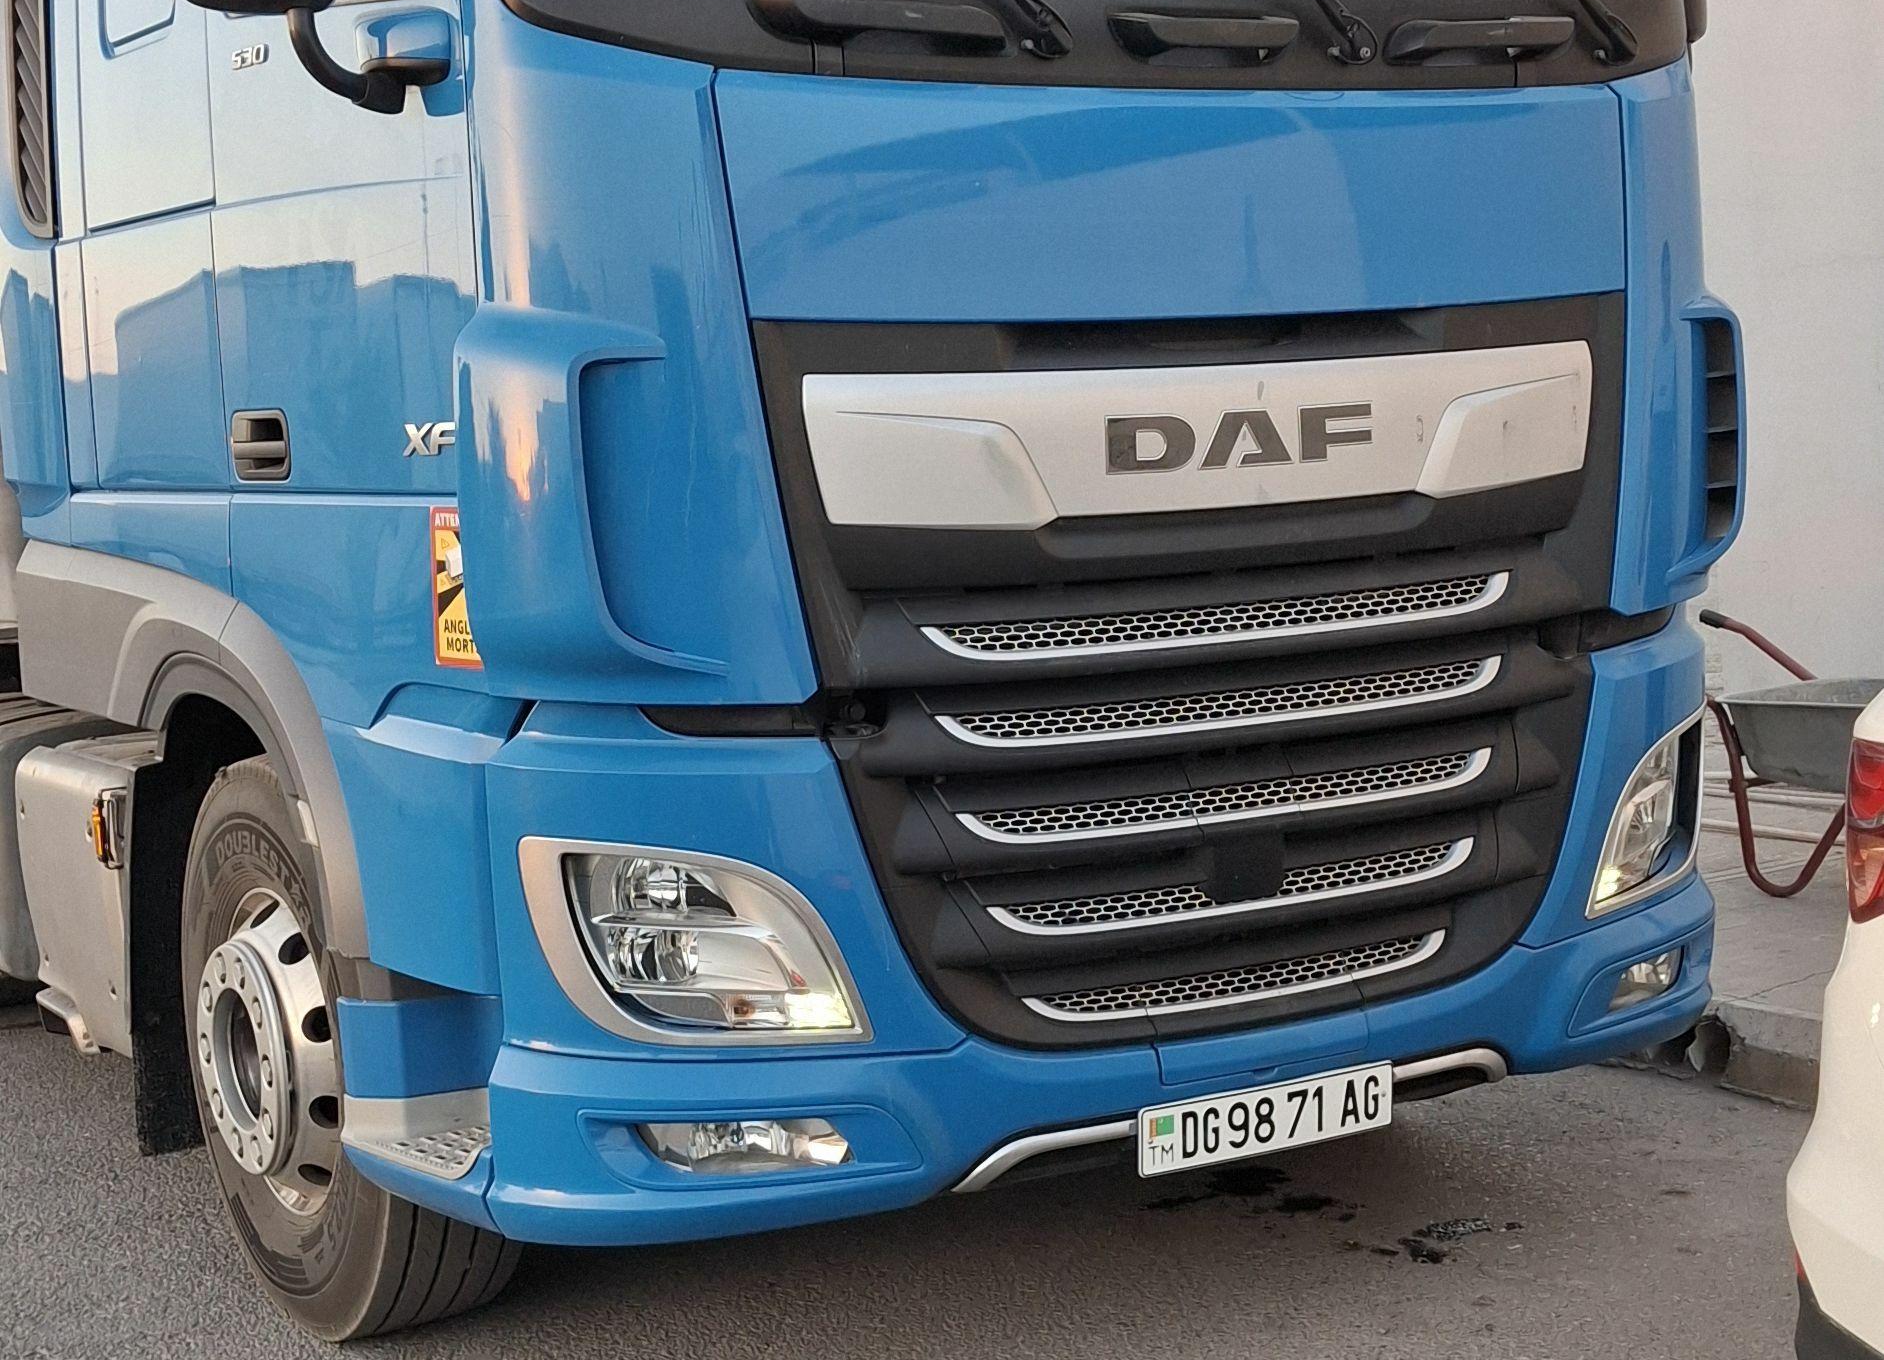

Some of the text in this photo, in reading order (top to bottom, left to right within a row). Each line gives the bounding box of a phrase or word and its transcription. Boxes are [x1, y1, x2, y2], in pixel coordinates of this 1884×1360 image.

[232, 43, 269, 70] 530
[402, 422, 456, 457] XF
[1104, 400, 1373, 475] DAF
[443, 618, 470, 635] ANGL
[446, 636, 474, 654] MORT
[1148, 1142, 1174, 1166] TM
